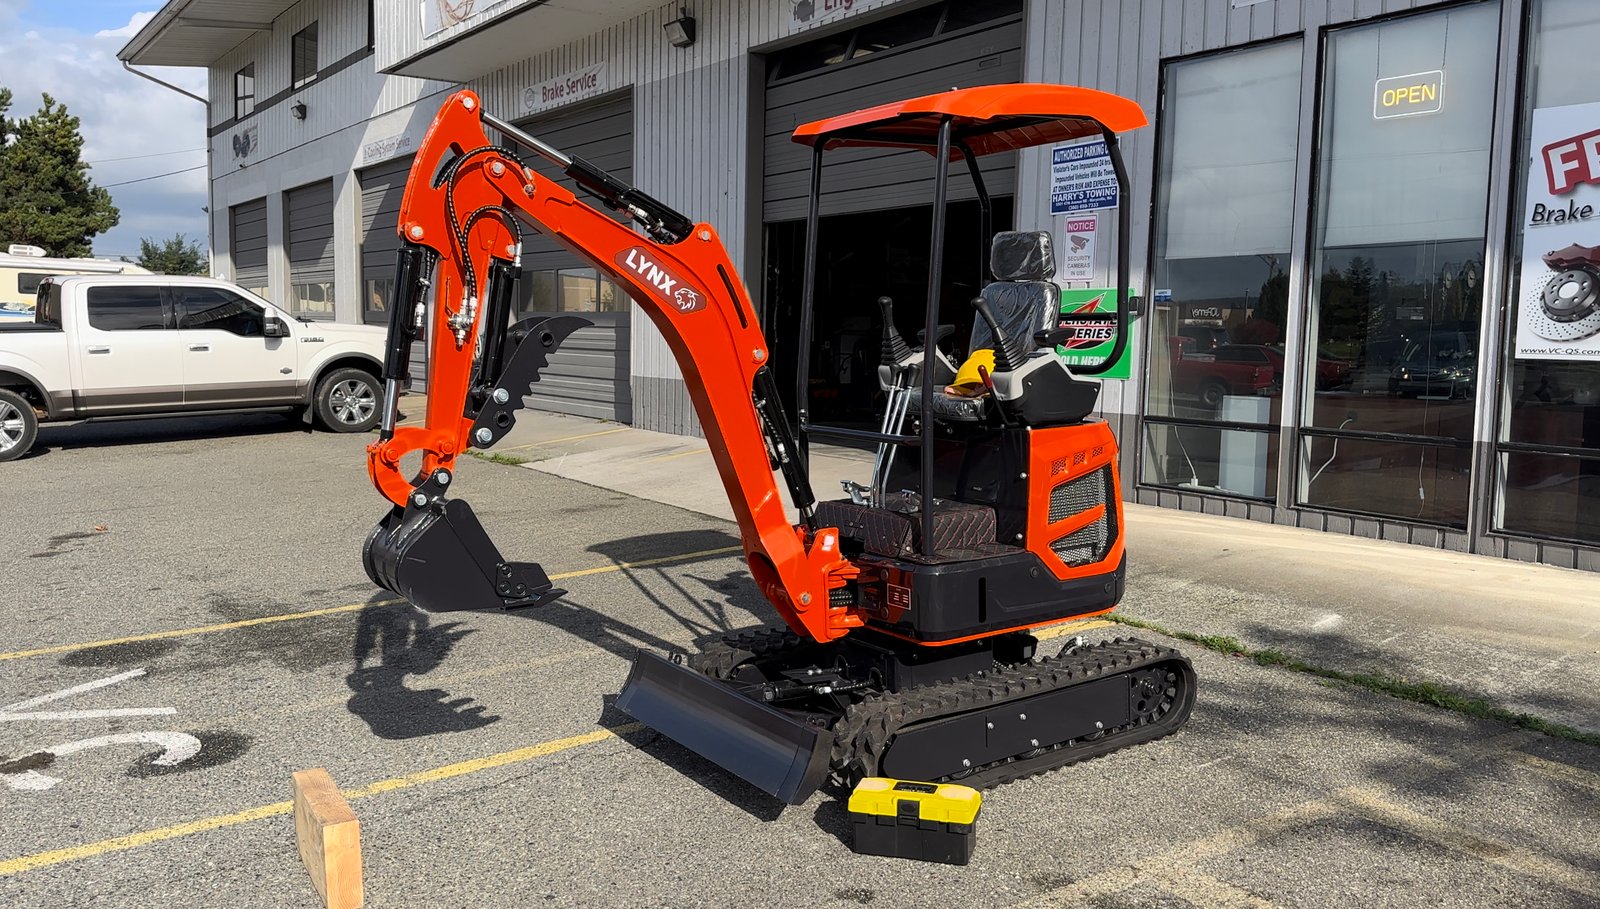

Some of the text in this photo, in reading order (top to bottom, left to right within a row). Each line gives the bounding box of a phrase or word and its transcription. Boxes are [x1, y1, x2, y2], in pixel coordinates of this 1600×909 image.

[542, 82, 564, 103] Brake
[566, 73, 597, 96] Service
[1382, 83, 1436, 107] OPEN
[1054, 147, 1084, 163] AUTHORIZED
[1084, 143, 1105, 158] PARKING
[1080, 161, 1099, 170] Impounded
[1055, 174, 1074, 184] Impounded
[1075, 172, 1090, 180] Vehicles
[1075, 182, 1084, 190] RISK
[1093, 178, 1110, 188] EXPENSE
[1052, 187, 1116, 203] HARRY'S TOWING
[1532, 199, 1592, 223] Brake
[1068, 221, 1094, 231] NOTICE
[625, 248, 677, 296] LYNX
